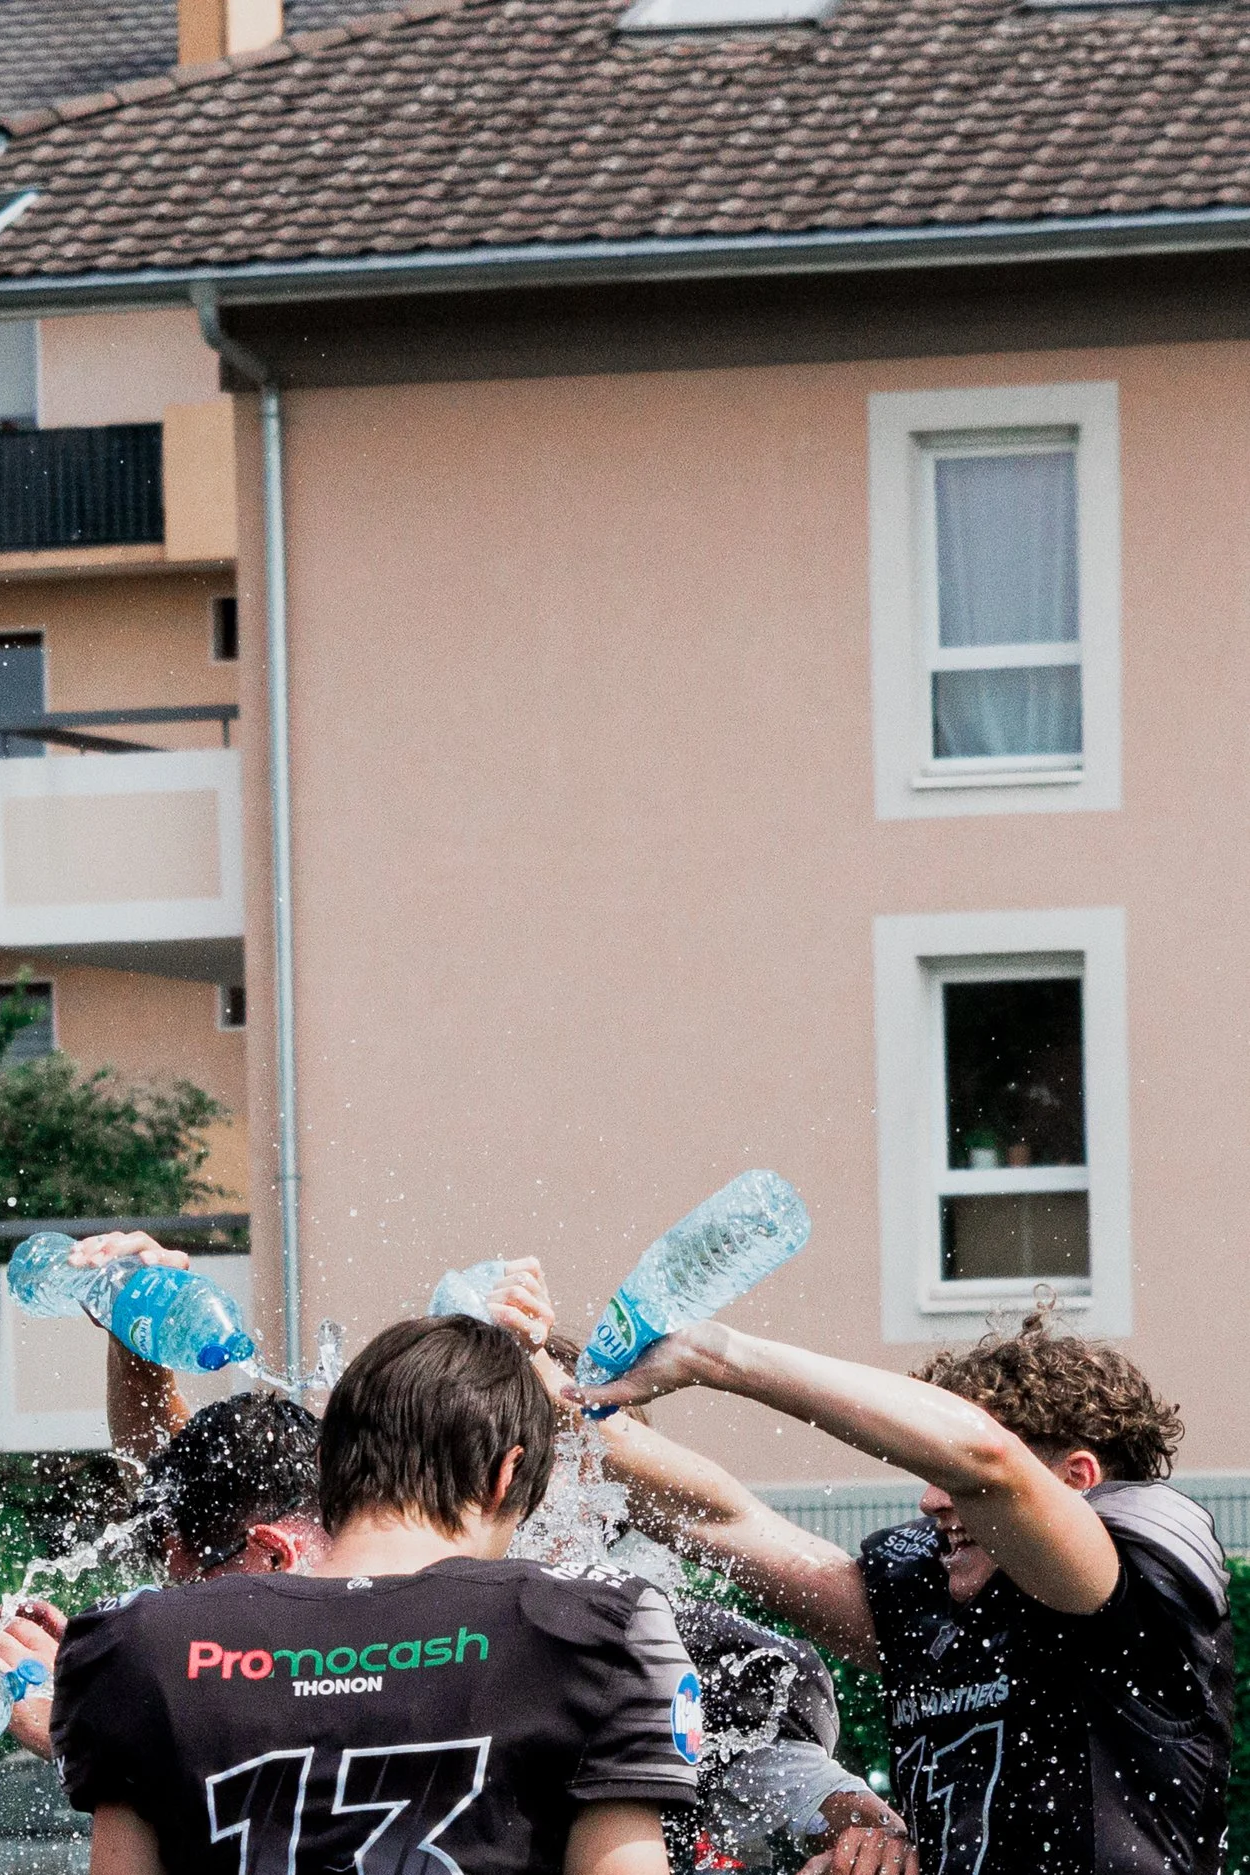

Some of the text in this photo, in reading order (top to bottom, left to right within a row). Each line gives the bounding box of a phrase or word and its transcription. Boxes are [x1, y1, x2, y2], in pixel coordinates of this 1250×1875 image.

[187, 1626, 490, 1680] Promocash
[292, 1675, 383, 1697] THONON
[919, 1673, 1009, 1718] PANTHERS
